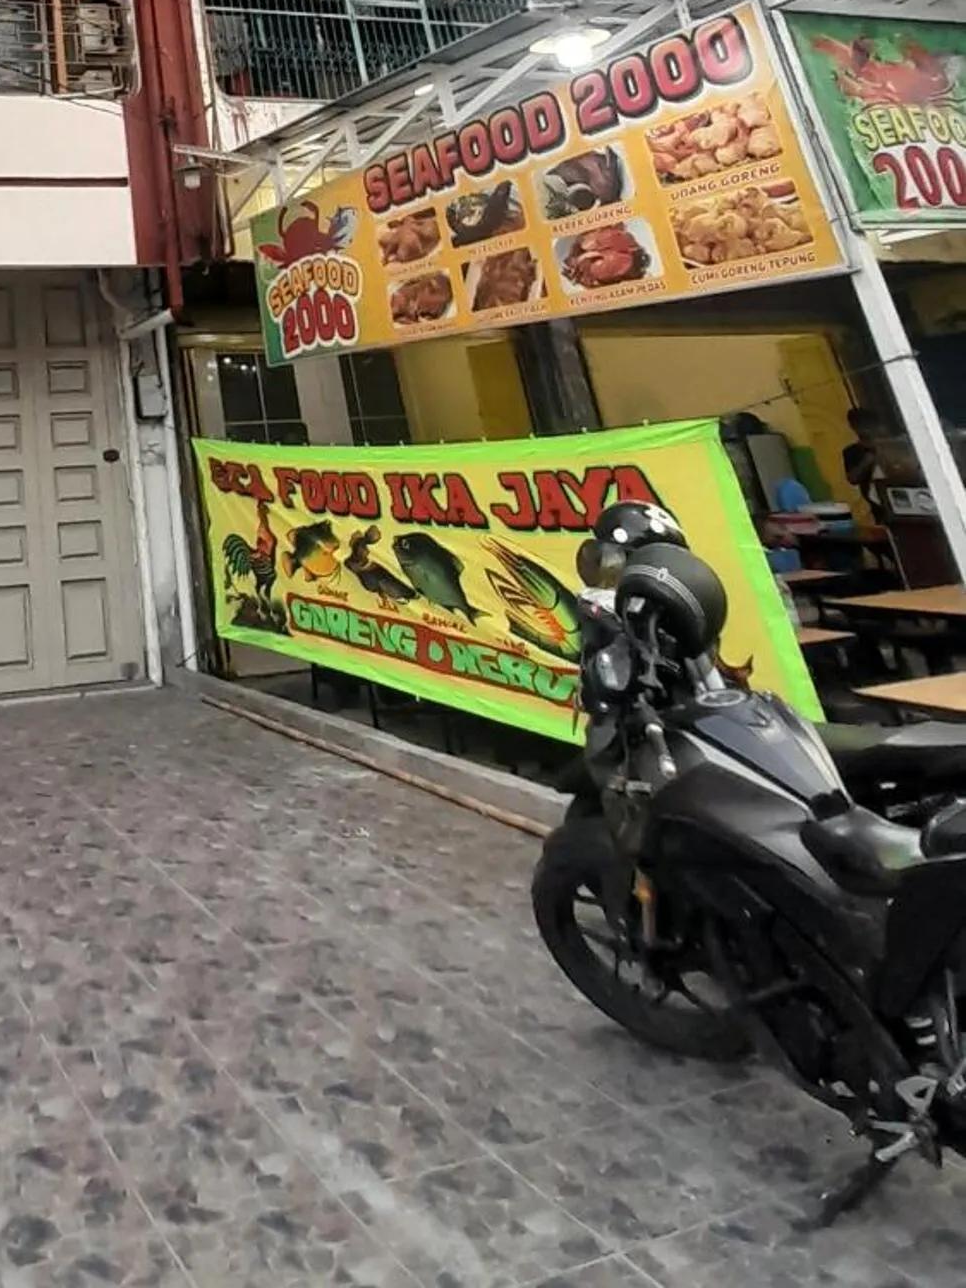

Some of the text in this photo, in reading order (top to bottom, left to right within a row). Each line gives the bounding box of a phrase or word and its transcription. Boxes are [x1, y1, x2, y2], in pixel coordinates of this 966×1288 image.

[363, 14, 751, 213] SEAFOOD 2000
[670, 163, 781, 200] UDANG GORENG
[268, 257, 359, 318] SEAFOOD
[691, 272, 720, 285] CUMI
[721, 261, 766, 280] GORENG
[283, 289, 356, 353] 2000
[273, 467, 382, 520] FOOD
[384, 472, 490, 529] IKA
[490, 466, 666, 532] JAYA
[291, 599, 576, 702] GORENG REBU
